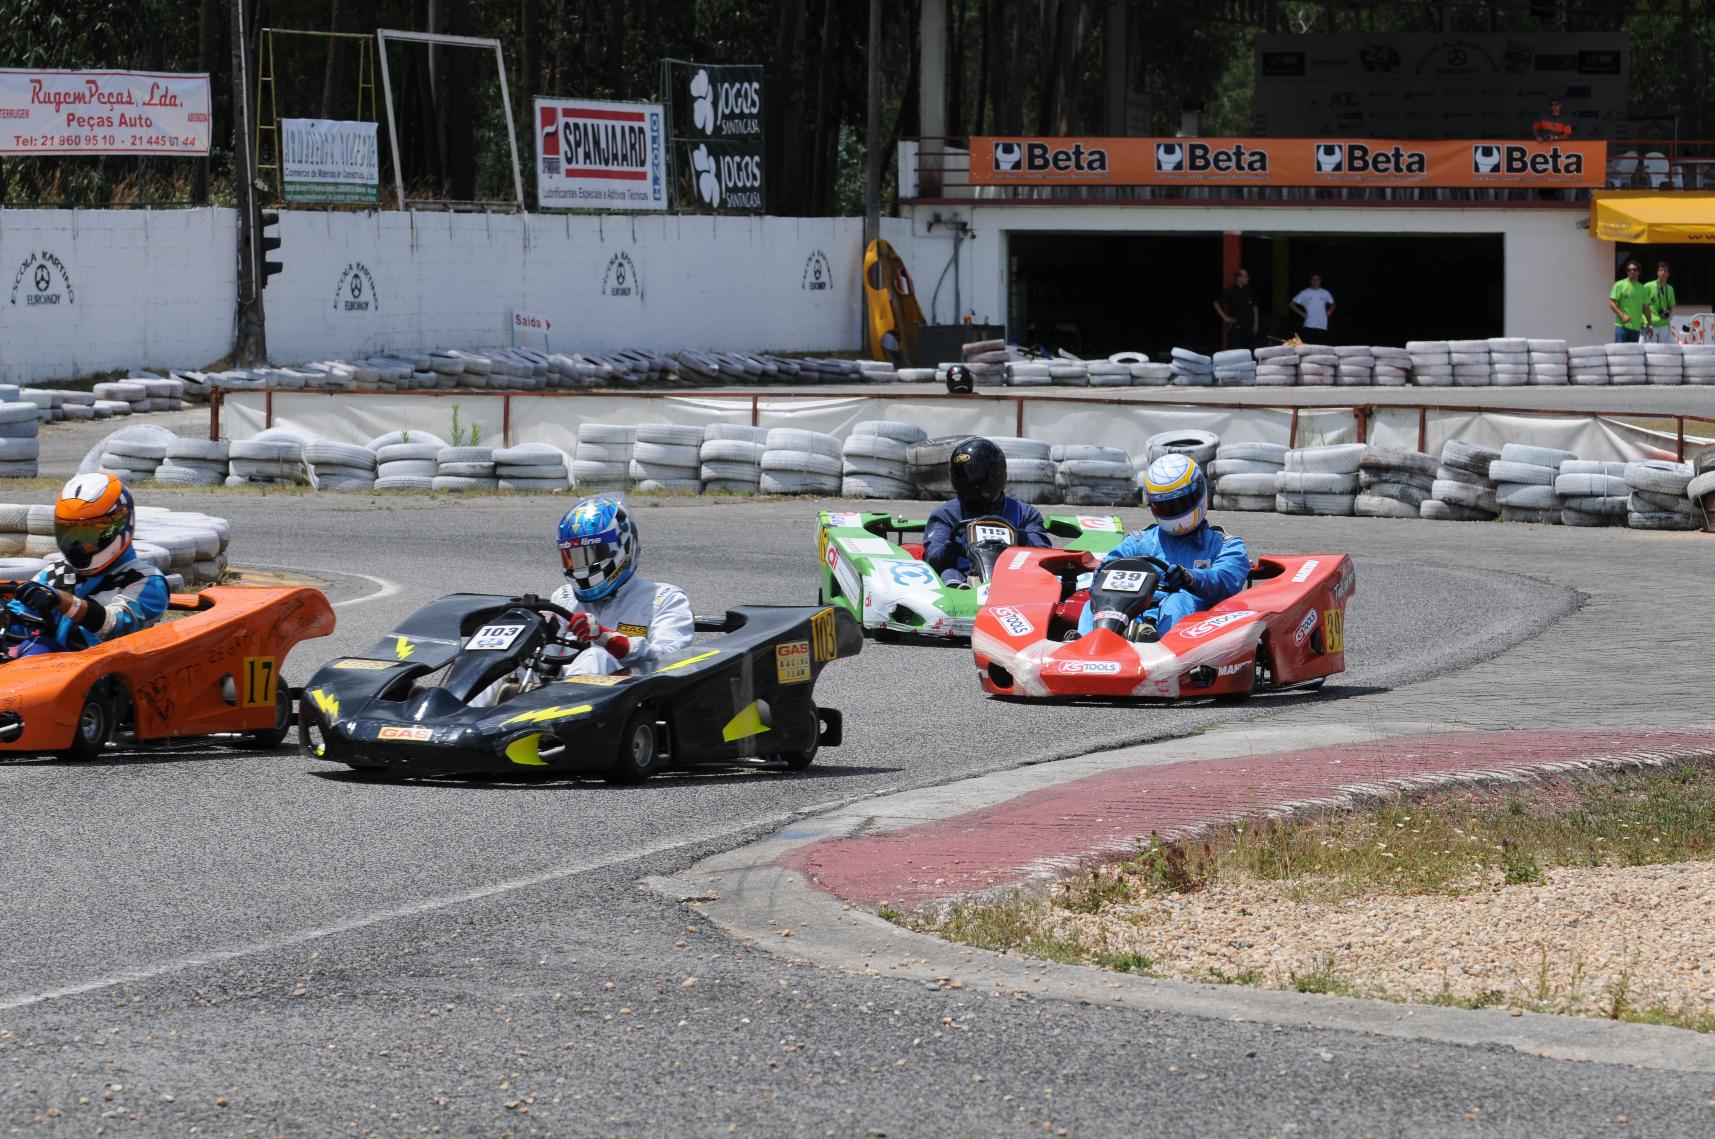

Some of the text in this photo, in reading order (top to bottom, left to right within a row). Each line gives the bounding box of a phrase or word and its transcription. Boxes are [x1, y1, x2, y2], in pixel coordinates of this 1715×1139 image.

[143, 81, 183, 108] Lda.
[717, 81, 760, 126] JOGOS
[66, 112, 153, 131] Peças Auto
[14, 136, 38, 147] Tel:
[40, 135, 55, 147] 21
[58, 135, 81, 147] 960
[84, 135, 98, 147] 95
[101, 135, 116, 147] 10
[131, 135, 143, 147] 21
[146, 135, 167, 147] 445
[182, 136, 196, 147] 44
[563, 121, 647, 168] SPANJAARD
[1027, 143, 1107, 171] Beta
[1188, 143, 1268, 171] Beta
[1346, 144, 1427, 174] Beta
[1505, 145, 1585, 174] Beta
[720, 155, 760, 199] JOGOS
[981, 527, 1006, 536] 115
[1113, 571, 1142, 582] 39
[482, 626, 519, 637] 103
[618, 624, 648, 637] GAS
[814, 611, 836, 661] 103
[1327, 610, 1341, 650] 39
[778, 643, 808, 657] GAS
[1083, 663, 1116, 671] TOOLS
[247, 658, 273, 705] 17
[381, 728, 428, 739] GAS
